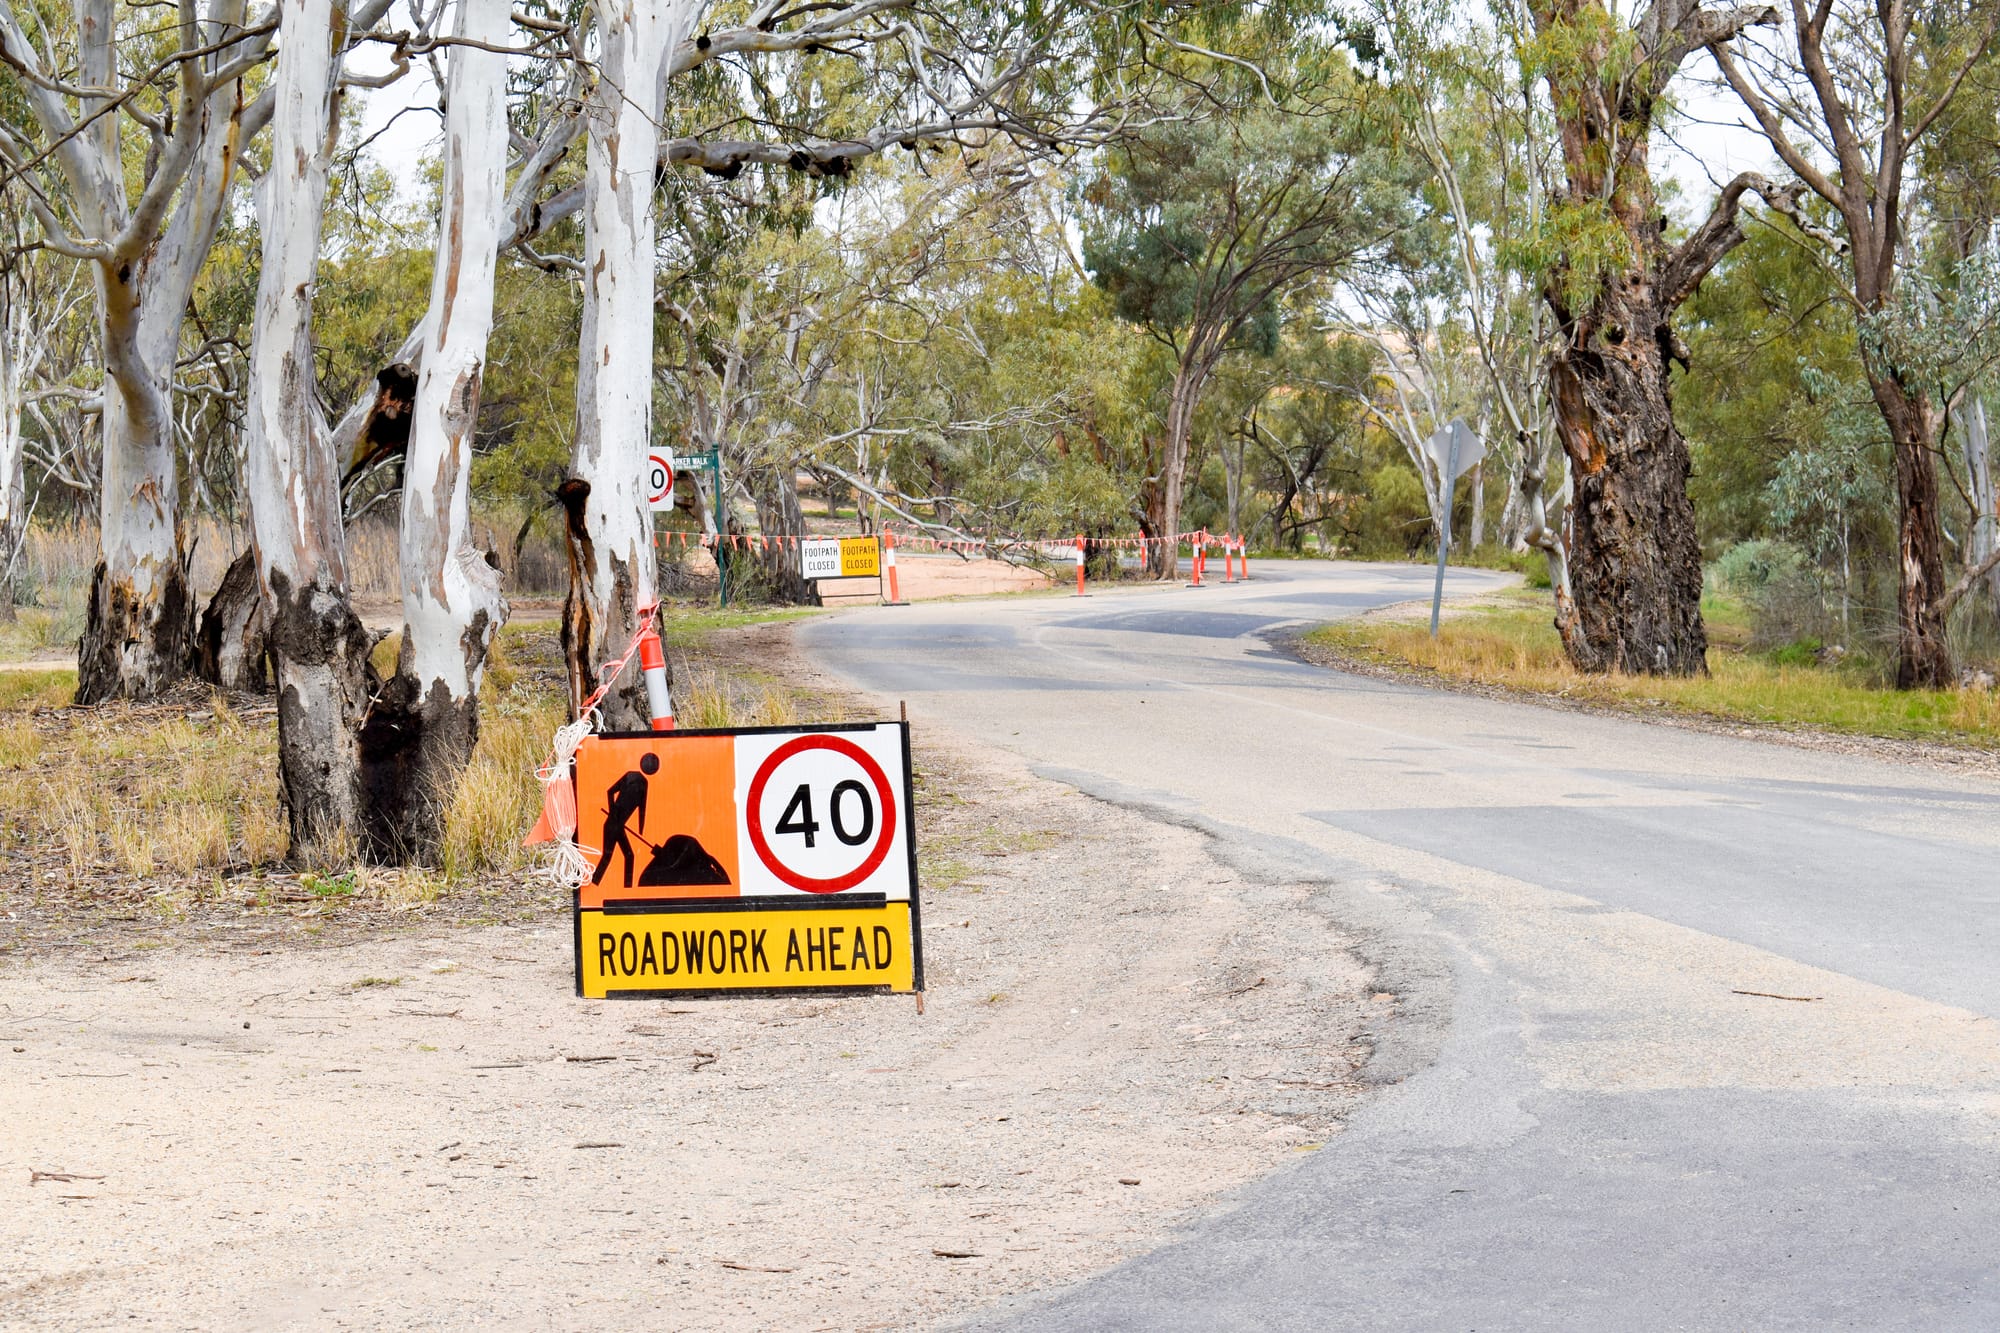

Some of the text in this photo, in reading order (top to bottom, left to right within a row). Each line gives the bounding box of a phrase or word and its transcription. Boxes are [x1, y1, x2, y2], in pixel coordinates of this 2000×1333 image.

[672, 457, 708, 465] ARKER WALK
[651, 469, 664, 489] 0
[804, 546, 838, 557] FOOTPATH
[842, 545, 876, 556] FOOTPATH
[808, 560, 836, 571] CLOSED
[846, 559, 873, 569] CLOSED
[775, 779, 874, 848] 40
[599, 925, 892, 977] ROADWORK AHEAD
